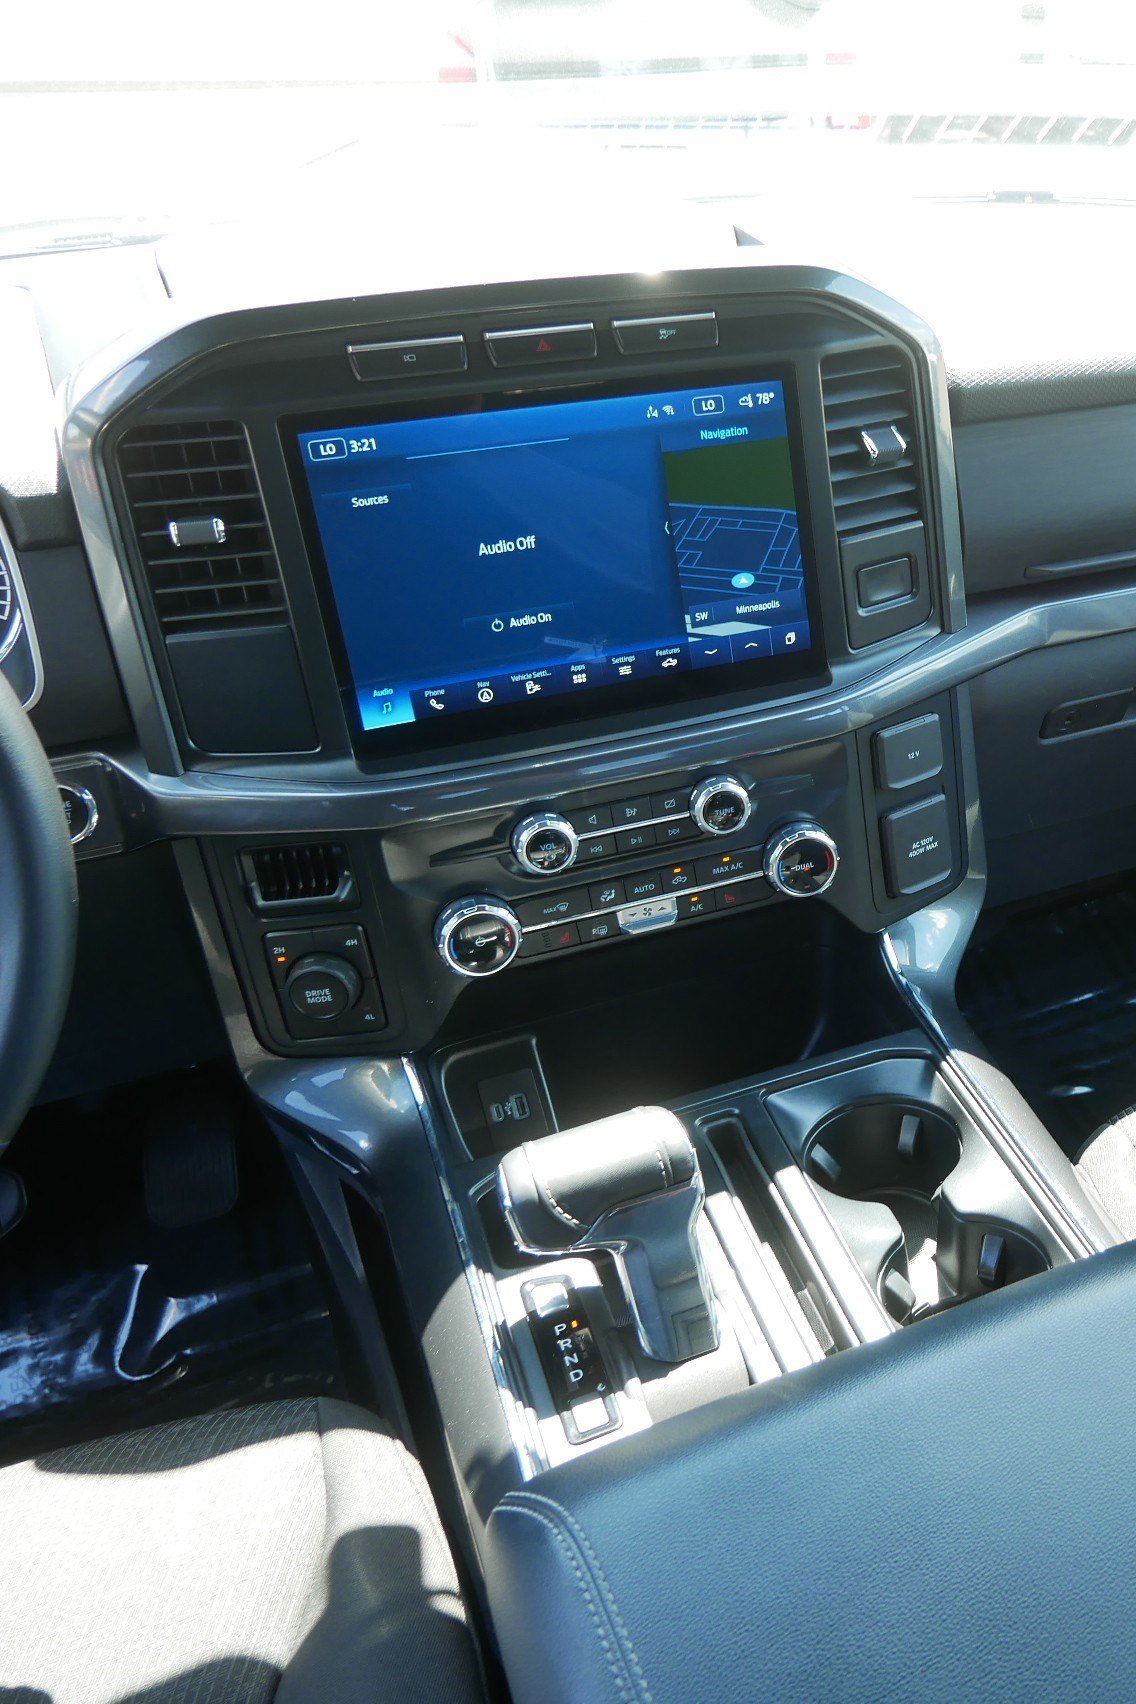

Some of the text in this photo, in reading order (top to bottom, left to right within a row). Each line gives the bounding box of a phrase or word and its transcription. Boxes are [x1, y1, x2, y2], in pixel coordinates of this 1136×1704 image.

[701, 399, 716, 411] LO
[700, 426, 749, 440] Navigation
[319, 443, 336, 456] LO
[348, 437, 377, 453] 3:21
[351, 495, 389, 508] Sources
[478, 535, 536, 556] Audio Off
[735, 600, 781, 615] Minneapolis
[509, 612, 552, 628] Audio On
[695, 611, 708, 622] SW
[655, 646, 681, 657] Features
[611, 654, 636, 665] Settings
[570, 663, 586, 672] Apps
[510, 672, 533, 683] Vehicle
[476, 680, 490, 689] Nav
[372, 687, 394, 698] Audio
[424, 688, 446, 698] Phone
[907, 752, 915, 760] 12
[714, 806, 735, 816] TUNE
[539, 842, 557, 851] VOL
[912, 835, 934, 849] AC 120V
[908, 841, 939, 858] 400W MAX
[712, 861, 744, 875] MAX A/C
[795, 861, 815, 872] DUAL
[634, 884, 655, 894] AUTO
[543, 904, 557, 915] MAX
[690, 903, 704, 912] A/C
[345, 939, 358, 947] 4H
[305, 988, 331, 998] DRIVE
[307, 994, 333, 1004] MODE
[554, 1323, 567, 1336] P
[559, 1338, 572, 1351] R
[564, 1352, 579, 1367] N
[569, 1369, 584, 1383] D
